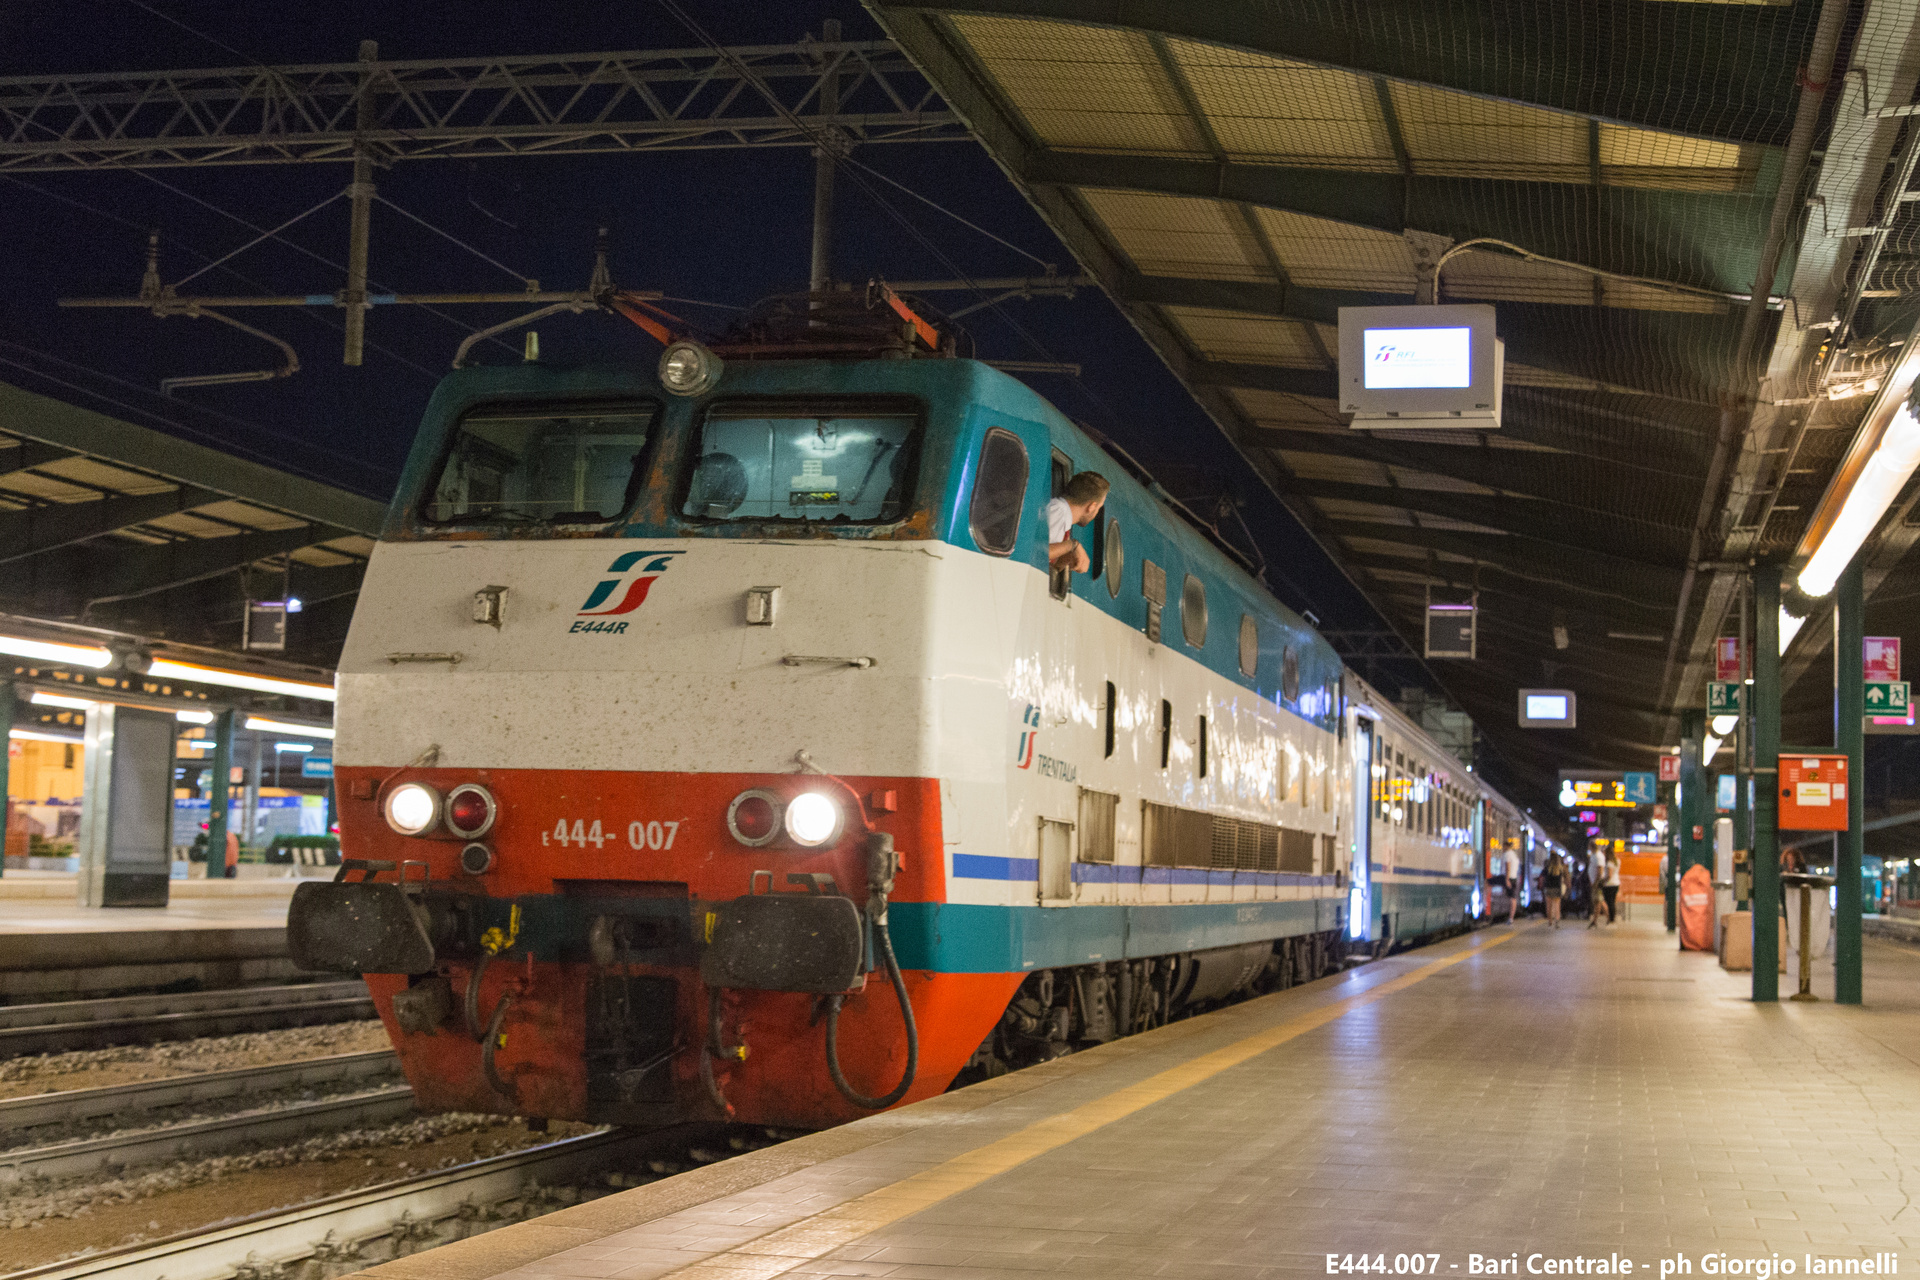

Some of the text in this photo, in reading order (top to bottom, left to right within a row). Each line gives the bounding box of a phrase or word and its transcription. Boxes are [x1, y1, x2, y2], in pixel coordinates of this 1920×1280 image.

[568, 620, 630, 635] E444R
[1037, 754, 1077, 782] TRENITALIA
[627, 820, 680, 851] 007
